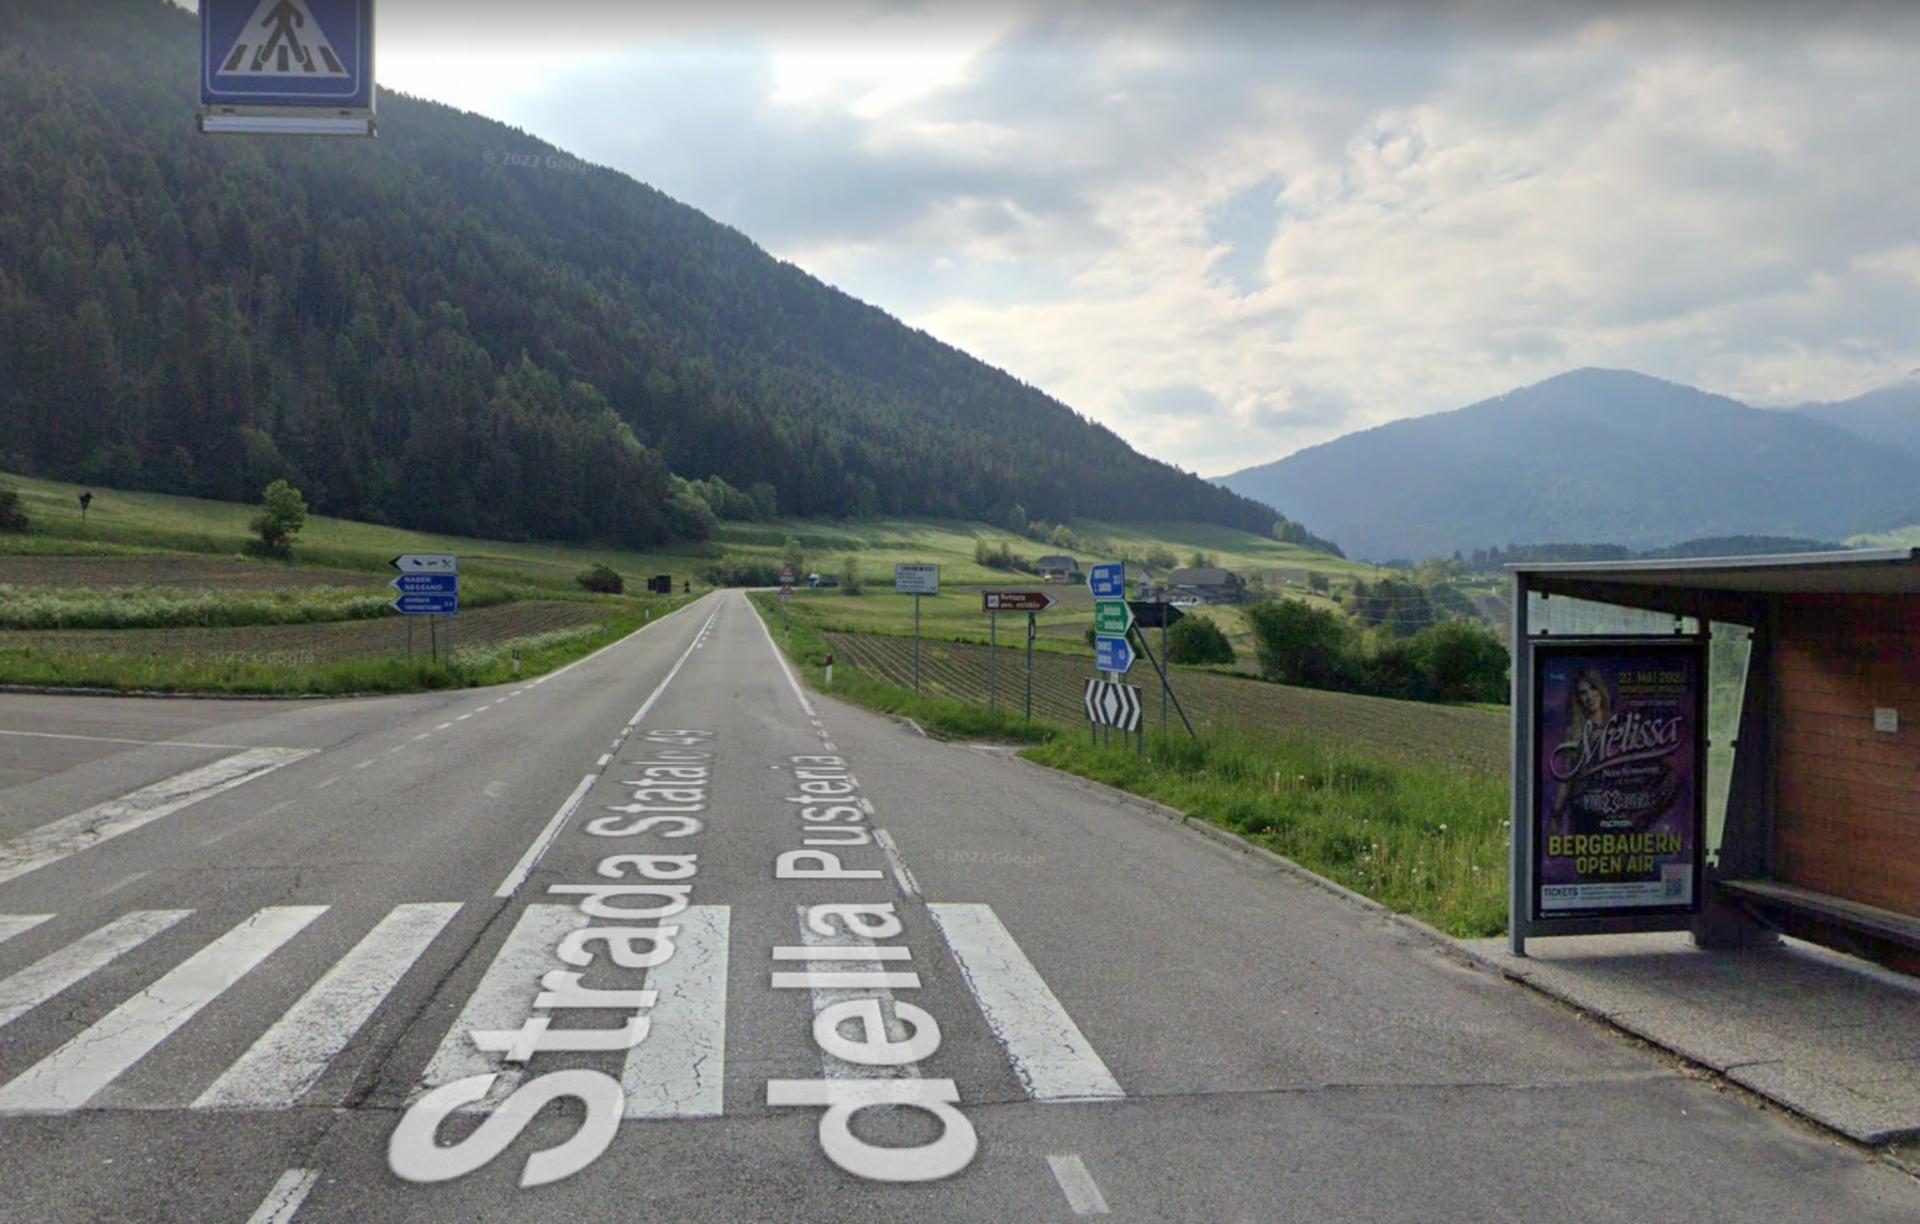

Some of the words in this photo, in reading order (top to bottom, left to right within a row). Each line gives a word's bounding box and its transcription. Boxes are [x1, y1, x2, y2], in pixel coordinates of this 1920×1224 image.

[1550, 712, 1684, 780] Melissa
[1548, 833, 1682, 855] BERGBAUERN
[1576, 856, 1622, 874] OPEN
[1627, 855, 1655, 873] AIR
[1544, 887, 1579, 897] TICKETS
